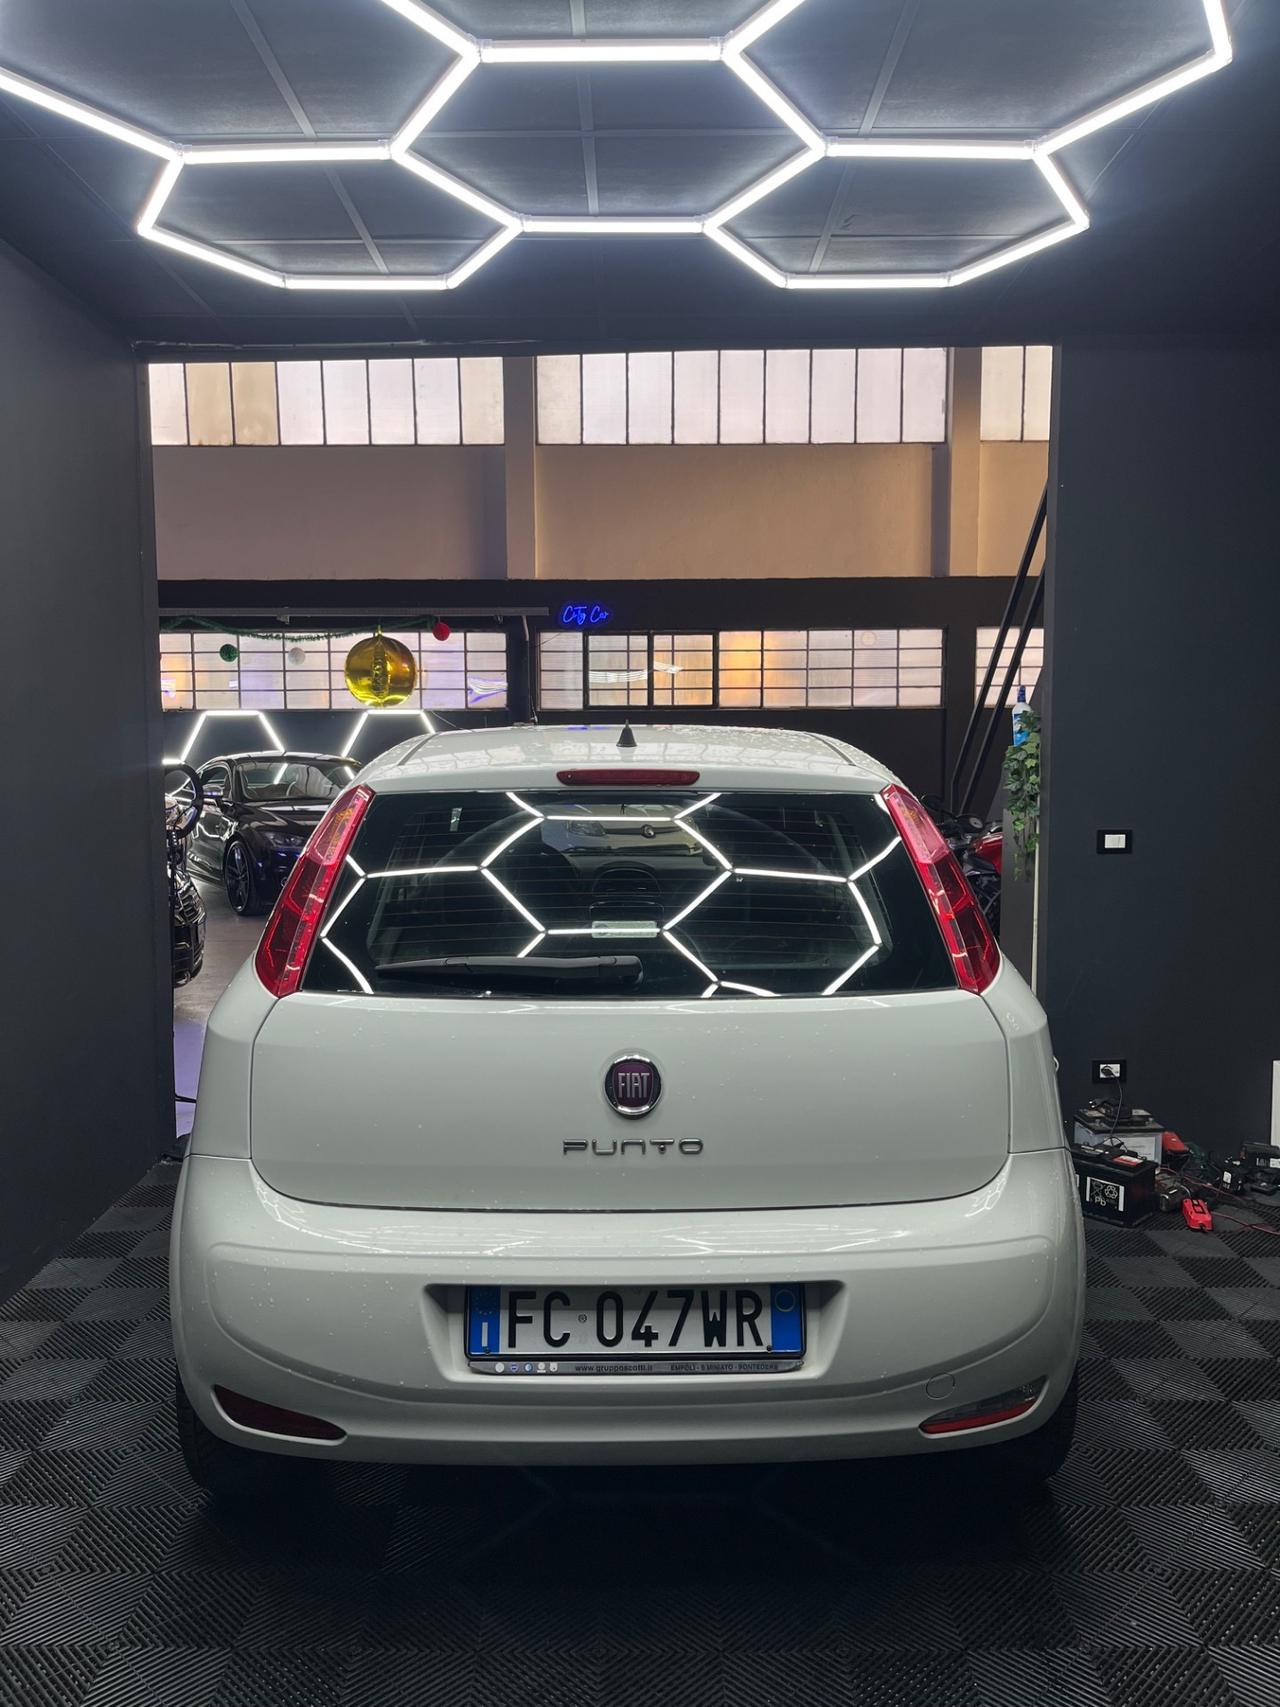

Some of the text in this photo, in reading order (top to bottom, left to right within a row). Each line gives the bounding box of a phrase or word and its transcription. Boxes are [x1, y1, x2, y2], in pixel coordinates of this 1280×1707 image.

[590, 605, 608, 623] Car
[617, 1072, 650, 1099] FIAT
[563, 1138, 703, 1156] PUNTO
[508, 1291, 570, 1348] FC
[597, 1290, 763, 1348] 047WR
